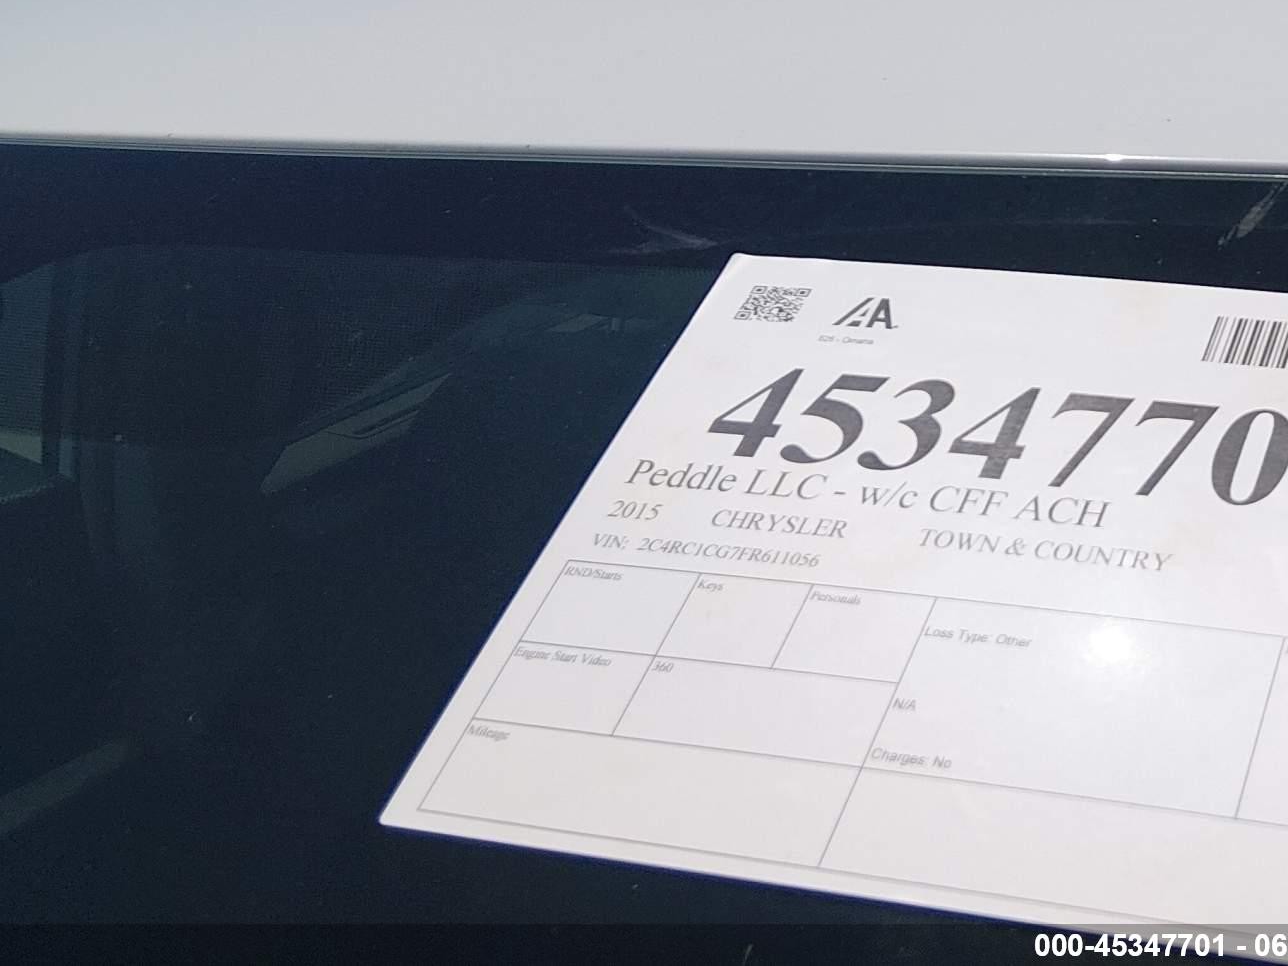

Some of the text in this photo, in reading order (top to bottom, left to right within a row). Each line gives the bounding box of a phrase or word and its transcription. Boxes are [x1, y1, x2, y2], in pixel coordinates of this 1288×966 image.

[624, 459, 738, 492] Peddle
[745, 469, 828, 500] LLC
[861, 482, 918, 509] w/c
[929, 486, 1008, 516] CFF
[1014, 495, 1112, 528] ACH
[607, 500, 1173, 571] 2015 CHRYSLER TOWN & COUNTRY
[593, 533, 820, 567] VIN: 2C4RC1CG7FR611056
[697, 579, 723, 592] Keys
[924, 627, 954, 639] Loss
[995, 634, 1032, 648] Other
[652, 661, 673, 673] 360
[892, 698, 916, 711] N/A
[932, 756, 952, 768] No
